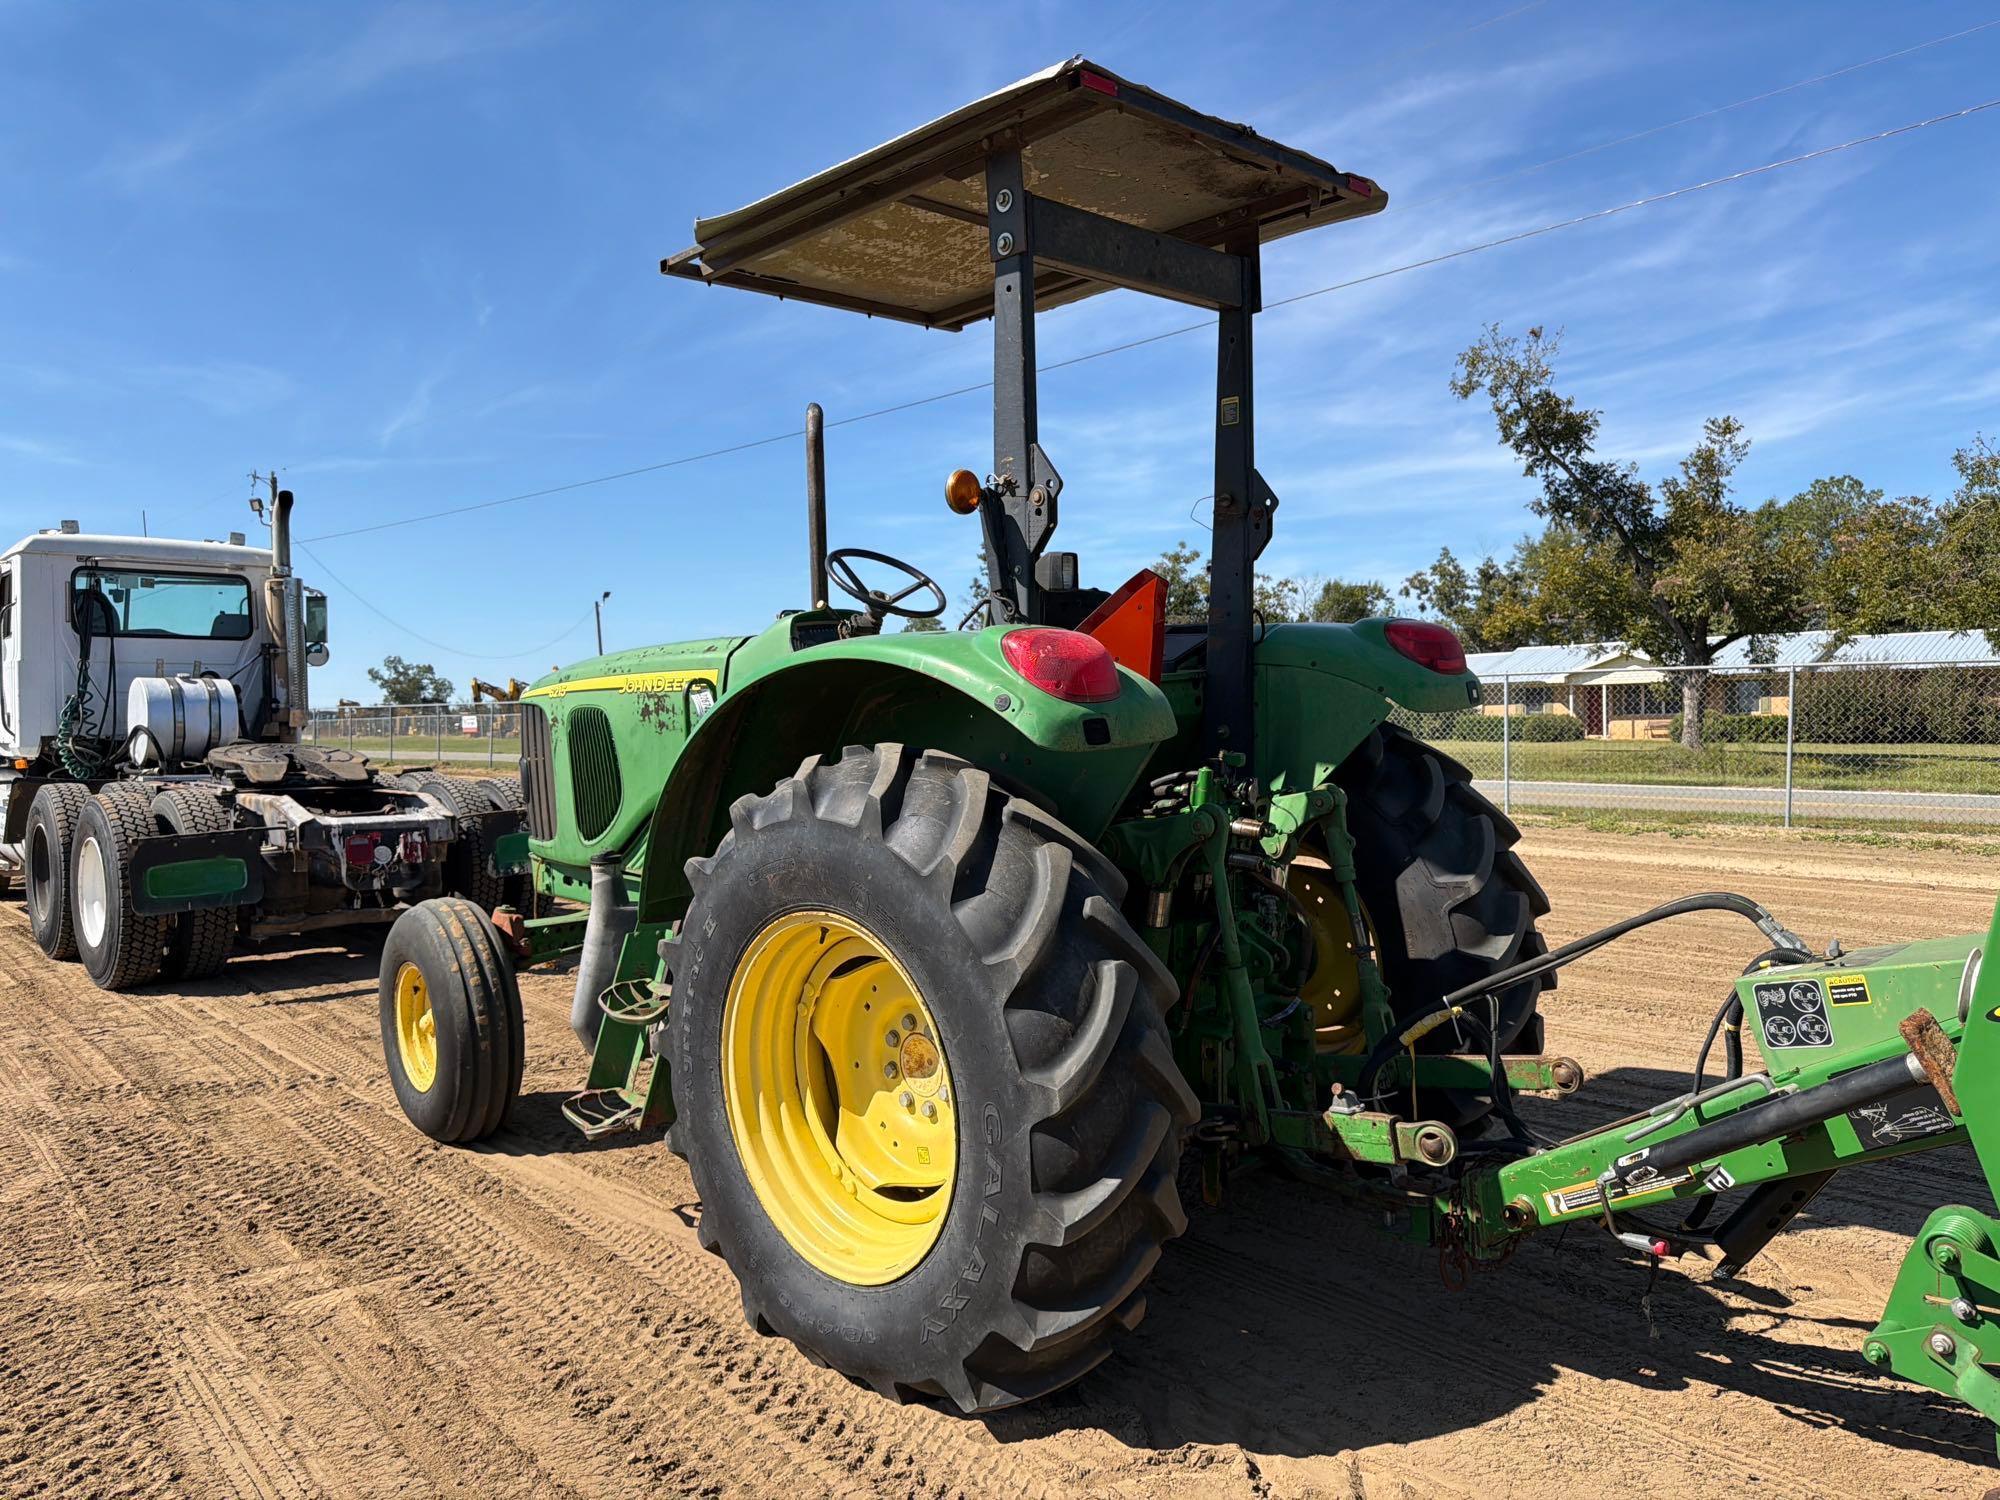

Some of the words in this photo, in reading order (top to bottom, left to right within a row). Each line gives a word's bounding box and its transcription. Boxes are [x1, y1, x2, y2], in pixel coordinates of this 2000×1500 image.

[619, 678, 654, 694] JOHN
[1833, 977, 1863, 985] CAUTION
[919, 1101, 1003, 1345] GALAXY
